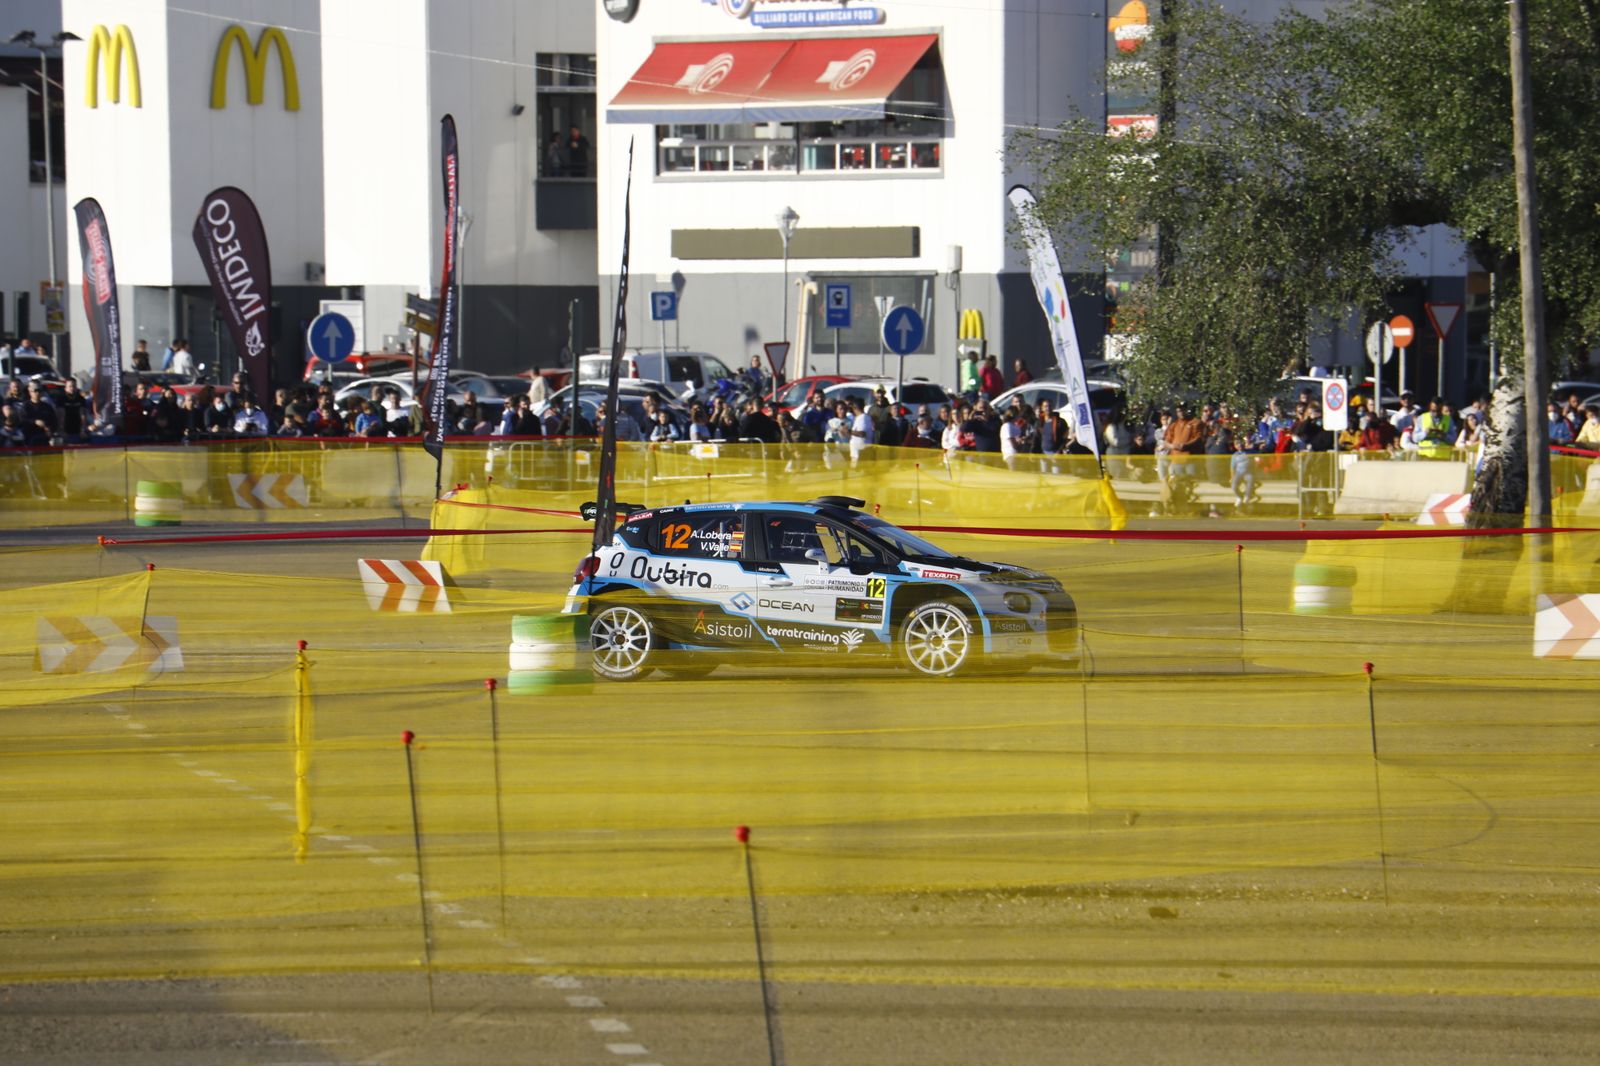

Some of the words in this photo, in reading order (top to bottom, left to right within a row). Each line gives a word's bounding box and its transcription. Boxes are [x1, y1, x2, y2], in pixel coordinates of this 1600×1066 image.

[754, 12, 787, 24] BILLIARD
[788, 11, 807, 23] CAFE
[815, 10, 852, 22] AMERICAN
[853, 9, 873, 21] FOOD
[656, 295, 671, 318] P
[661, 523, 692, 549] 12
[690, 530, 732, 540] A.Lobera
[867, 578, 884, 598] 12
[759, 599, 815, 613] OCEAN
[694, 620, 752, 639] Asistoil
[767, 625, 839, 645] terratraining
